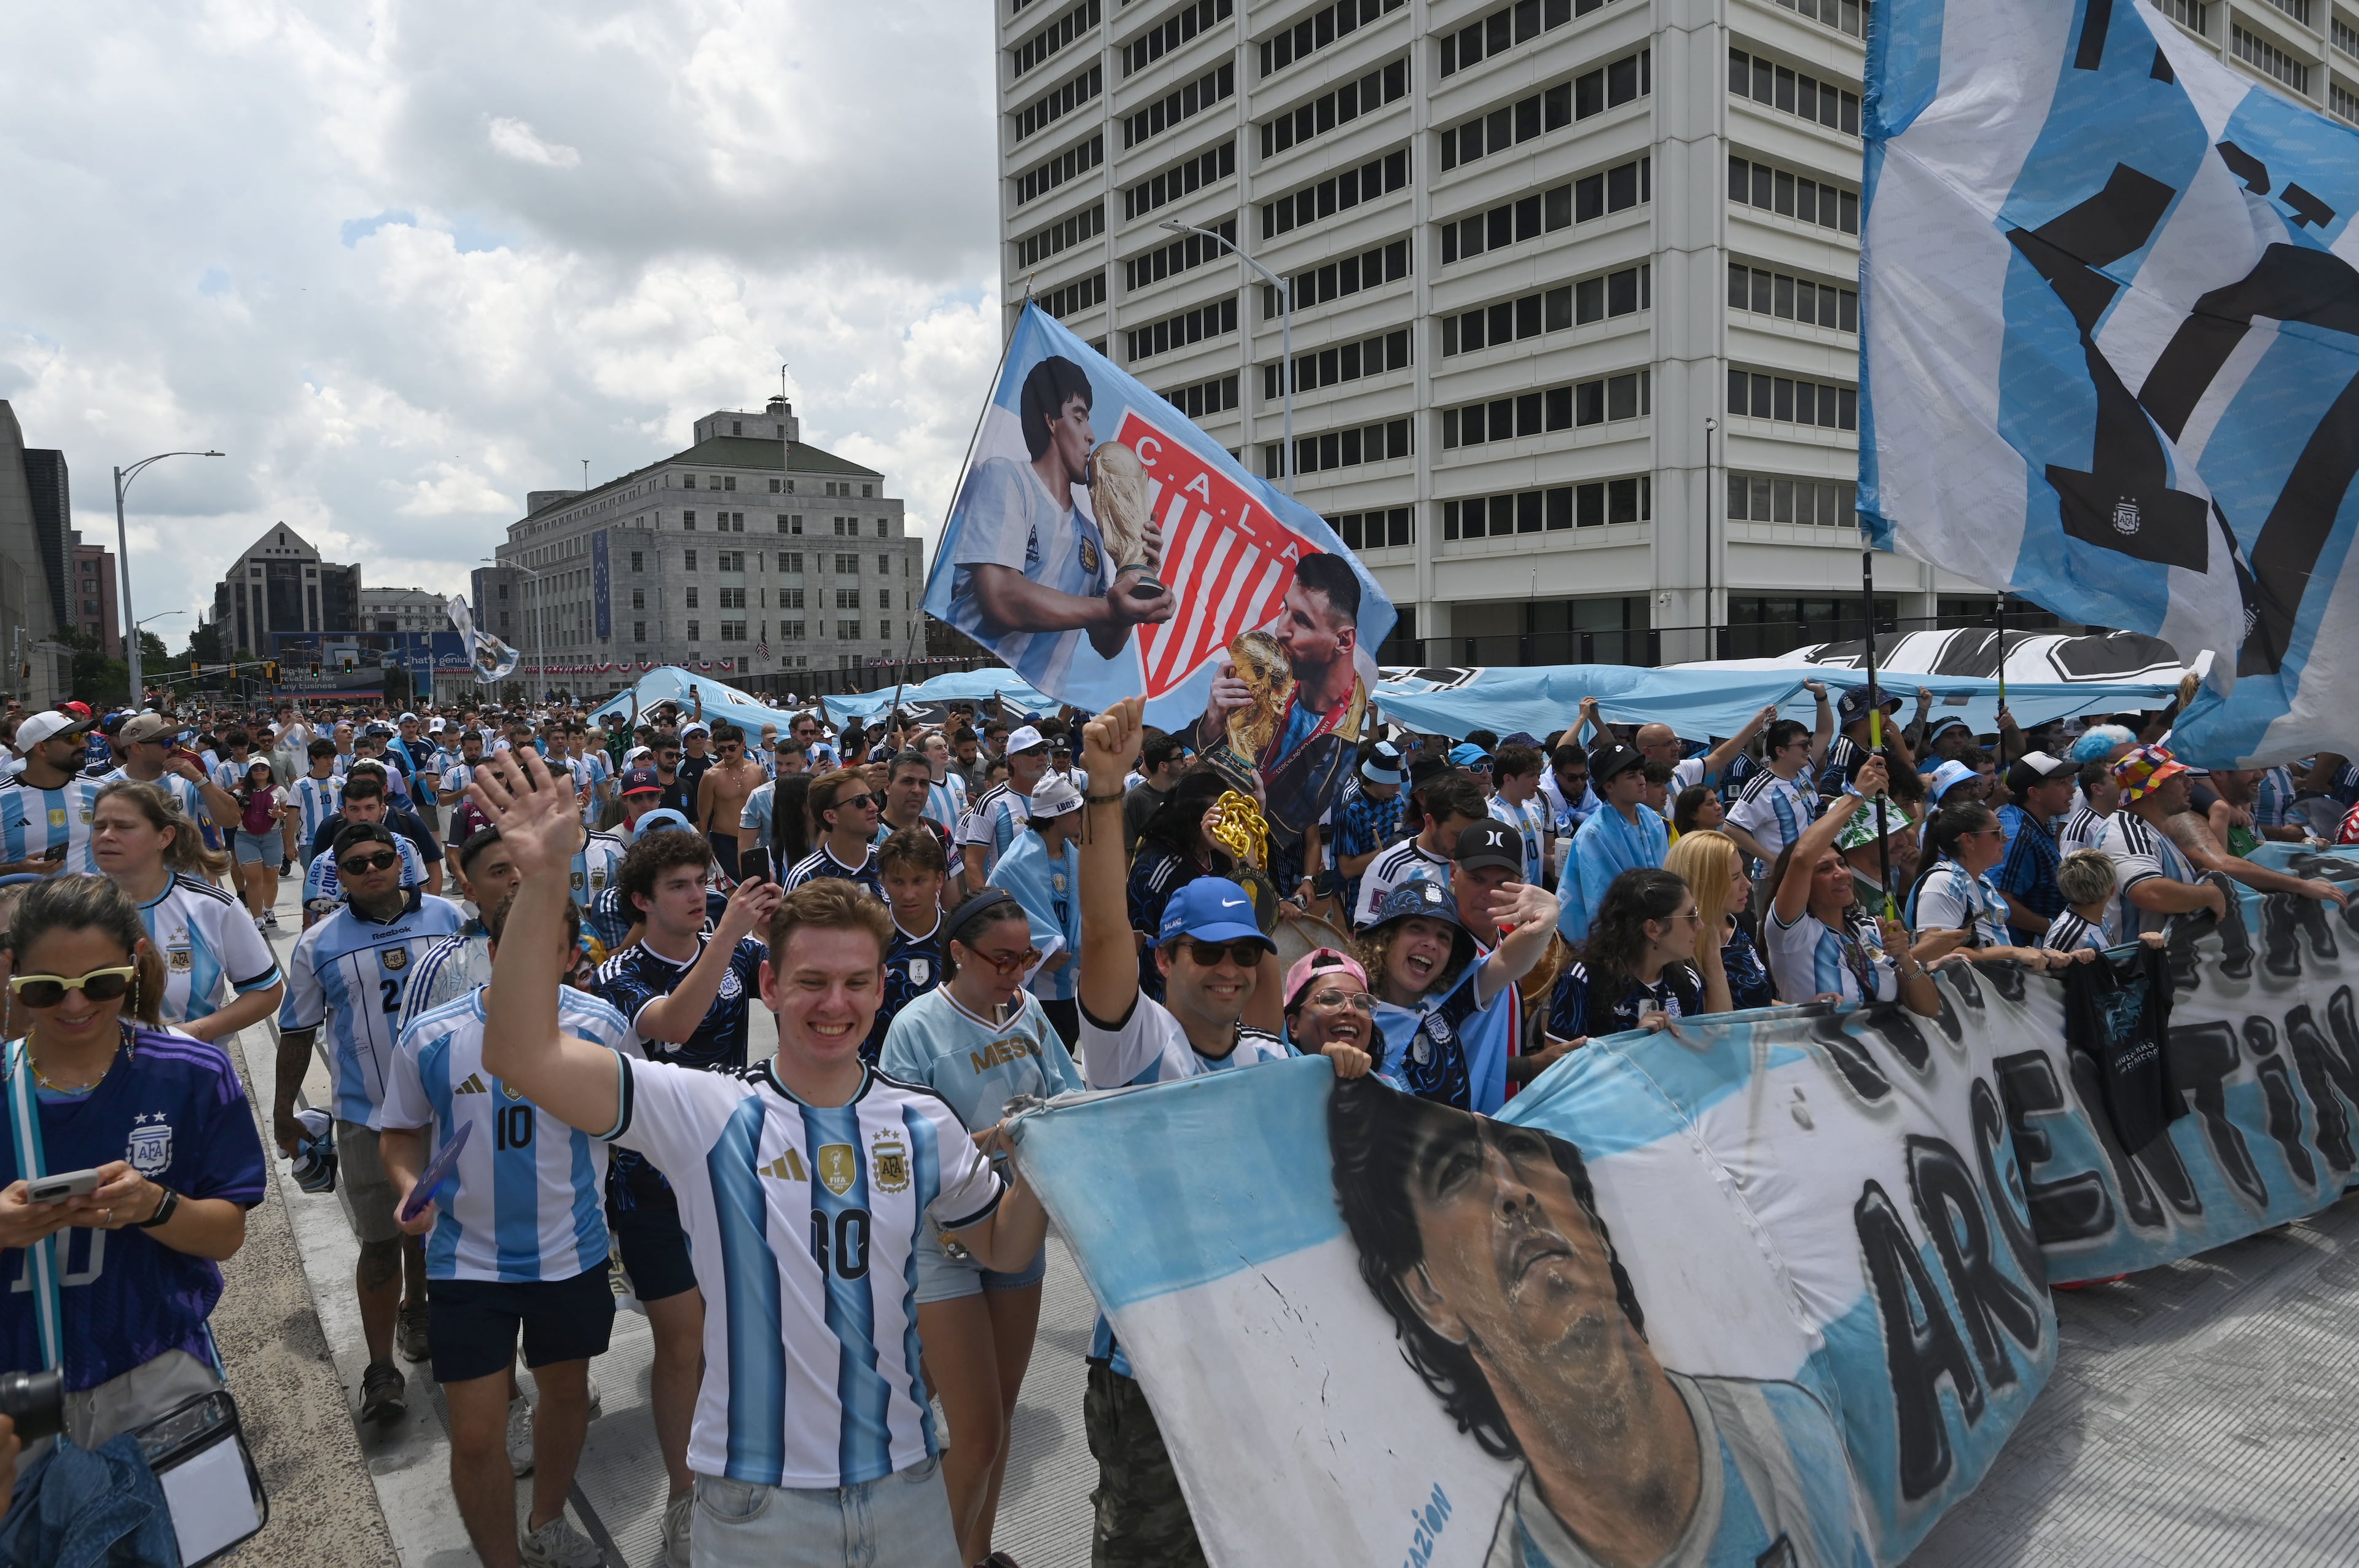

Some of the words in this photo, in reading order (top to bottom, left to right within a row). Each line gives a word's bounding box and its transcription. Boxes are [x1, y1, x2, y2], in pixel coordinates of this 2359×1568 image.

[2119, 512, 2134, 526] AFA
[319, 794, 332, 805] 10
[1230, 867, 1251, 880] WORLD
[1252, 869, 1265, 879] CUP
[1165, 918, 1182, 931] BALANZ
[372, 926, 412, 940] Reebok
[172, 952, 189, 966] AFA
[722, 977, 735, 990] AFA
[380, 975, 410, 1014] 2
[498, 1106, 532, 1151] 10
[138, 1140, 163, 1161] AFA
[882, 1155, 902, 1178] AFA
[811, 1208, 871, 1281] 10
[10, 1226, 106, 1293] 0
